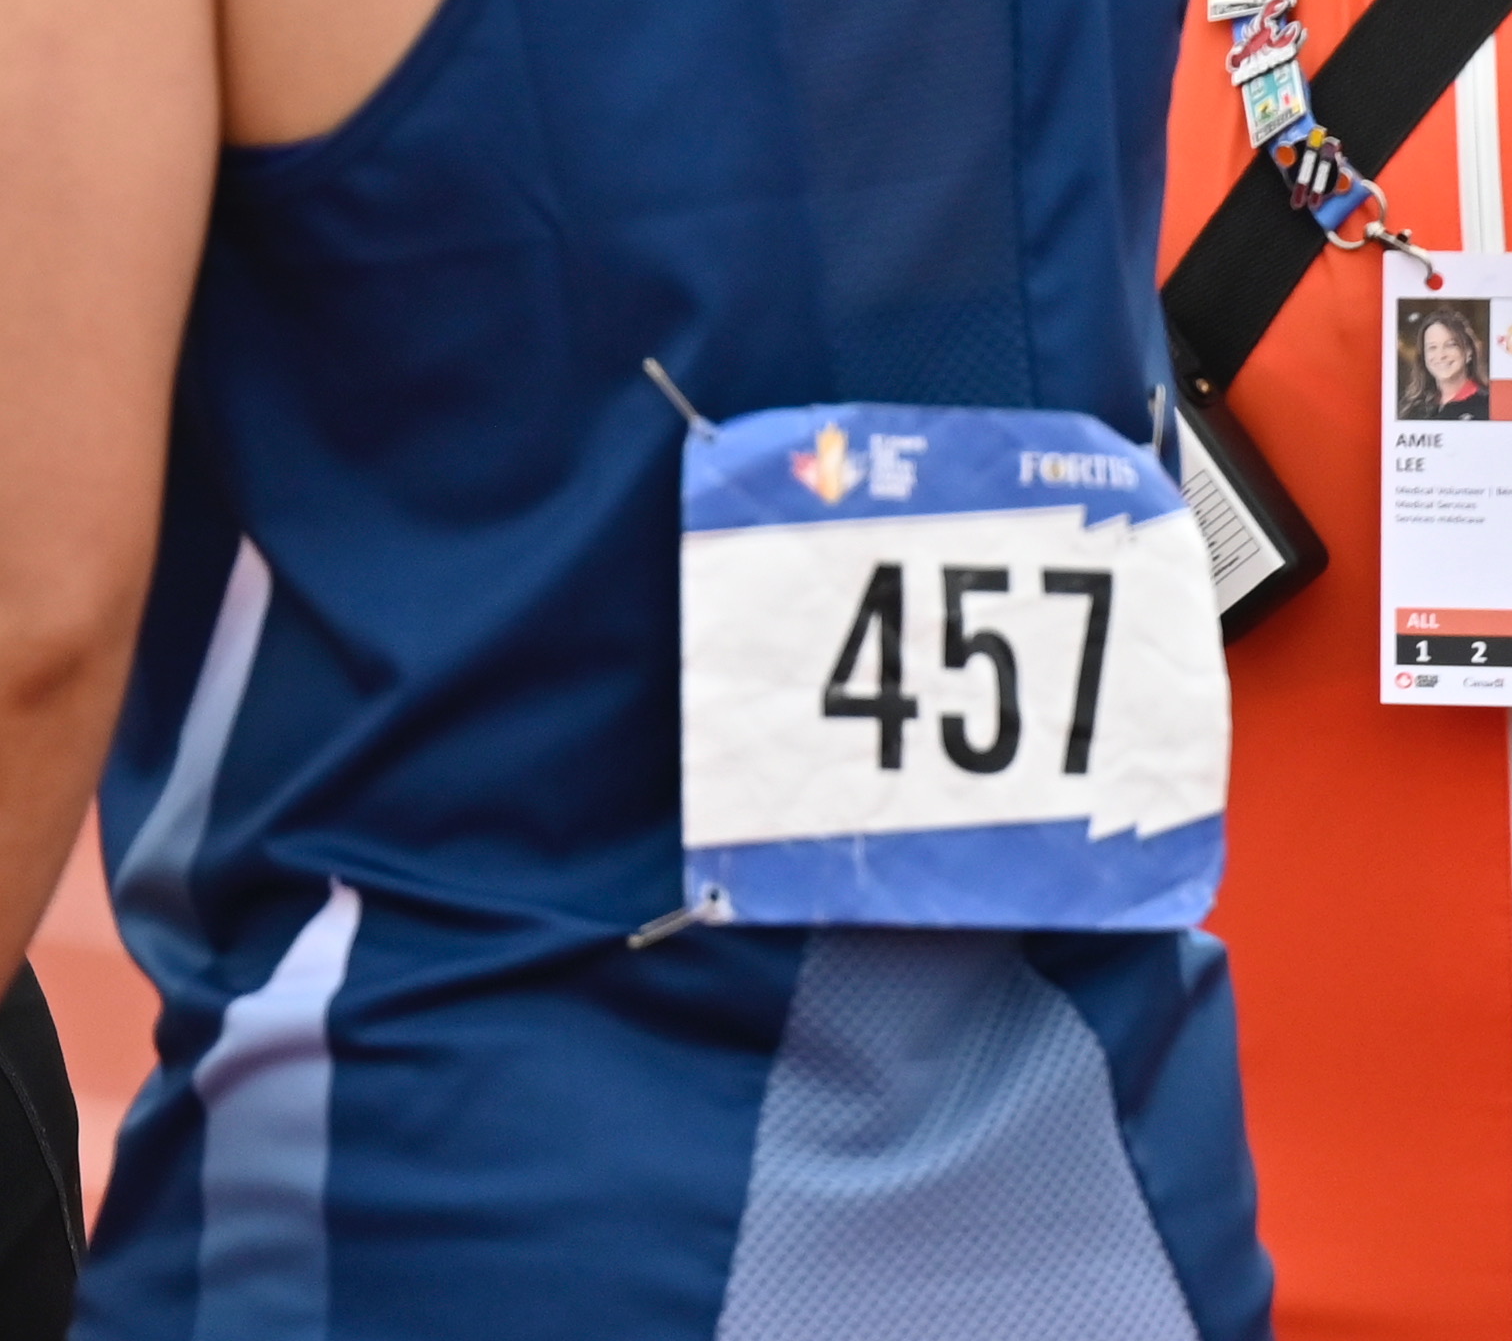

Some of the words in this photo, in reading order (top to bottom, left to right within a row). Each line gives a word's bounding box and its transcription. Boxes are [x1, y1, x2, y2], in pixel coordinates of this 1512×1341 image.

[1395, 433, 1444, 449] AMIE
[1396, 457, 1426, 473] LEE
[1406, 612, 1441, 629] ALL
[1415, 639, 1432, 663] 1
[1470, 640, 1488, 664] 2
[820, 561, 1114, 776] 457
